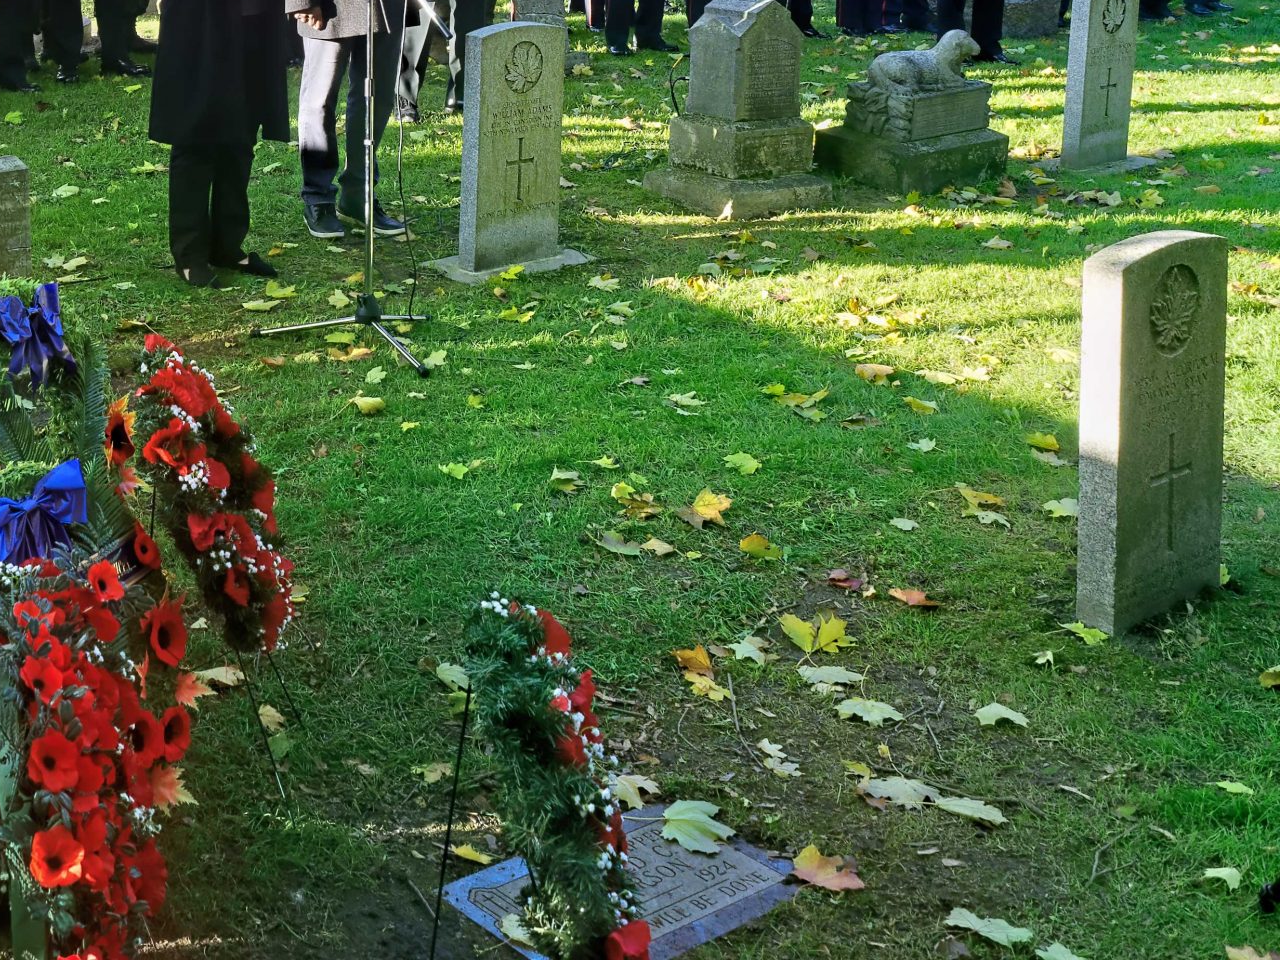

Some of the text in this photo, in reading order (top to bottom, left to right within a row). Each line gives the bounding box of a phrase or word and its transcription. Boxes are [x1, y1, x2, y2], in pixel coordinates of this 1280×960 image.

[633, 857, 695, 894] RSON
[694, 860, 738, 883] 1924
[648, 907, 692, 929] WILL
[688, 894, 719, 911] BE
[717, 870, 770, 898] DONE
